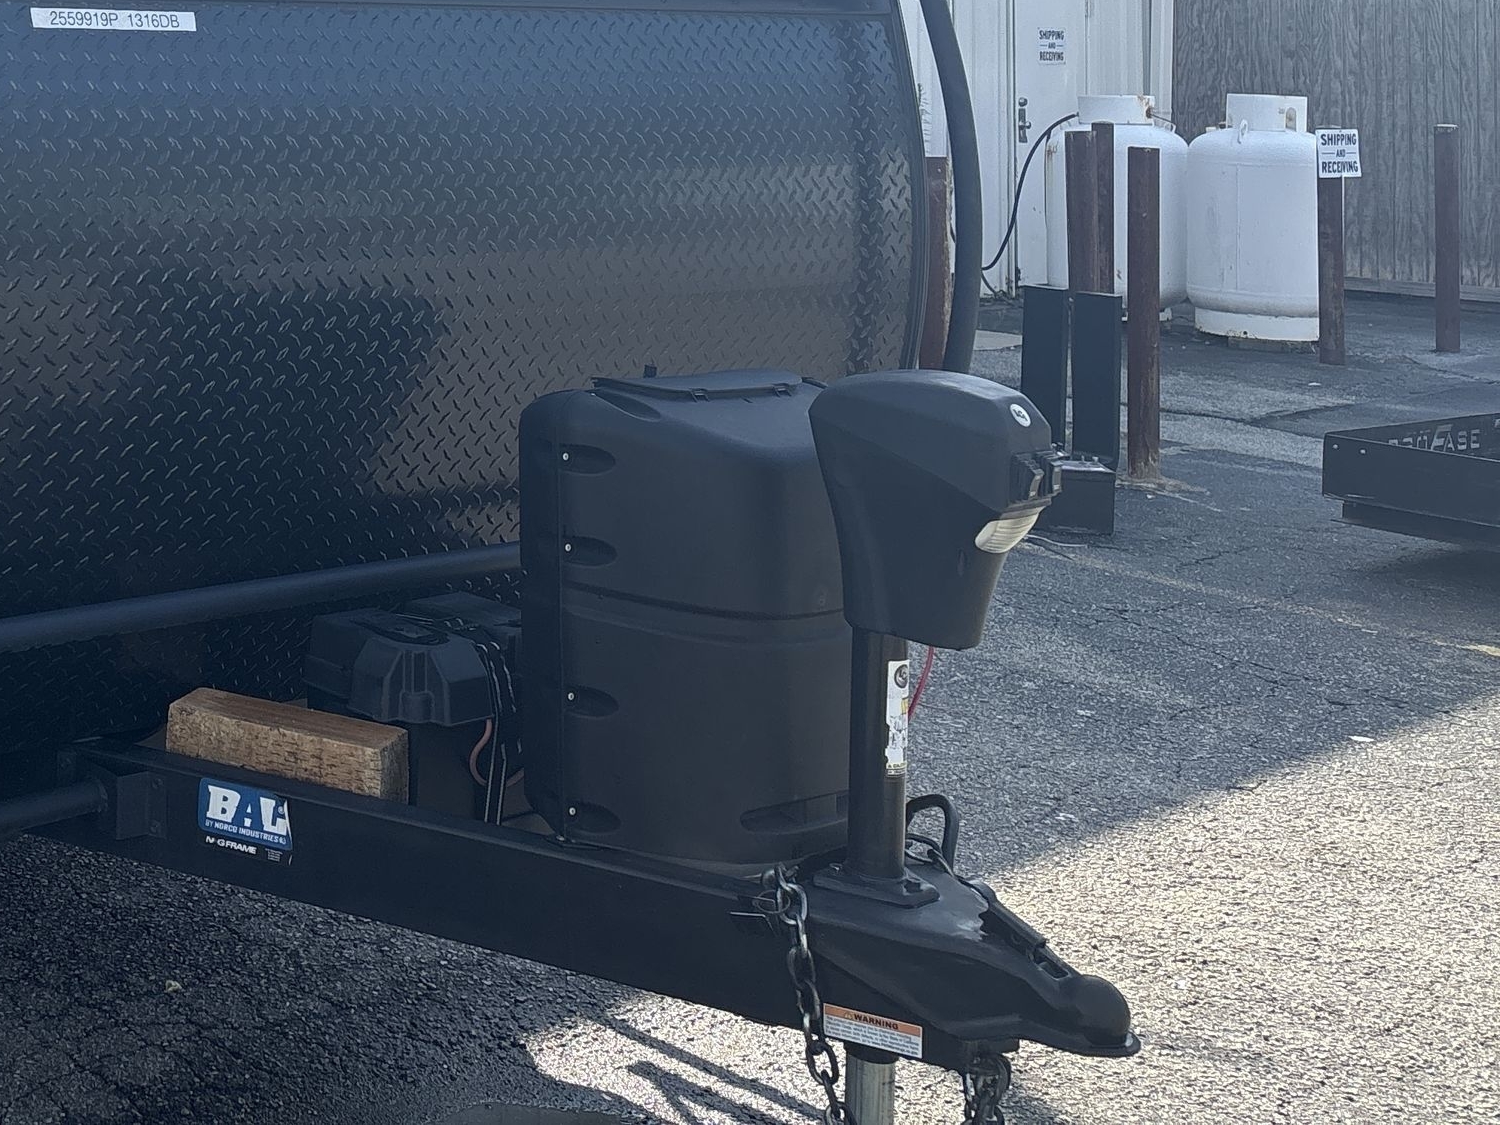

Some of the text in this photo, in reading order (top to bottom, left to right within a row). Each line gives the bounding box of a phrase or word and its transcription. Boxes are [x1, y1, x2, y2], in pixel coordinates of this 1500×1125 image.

[50, 11, 180, 28] 2559919P 1316DB
[1039, 30, 1064, 40] SHIPPING
[1040, 51, 1064, 61] RECEIVING
[1320, 133, 1357, 146] SHIPPING
[1335, 149, 1346, 158] AND
[1321, 161, 1359, 174] RECEIVING
[205, 818, 279, 843] BY NORCO INDUSTRIES
[854, 1013, 898, 1029] WARNING
